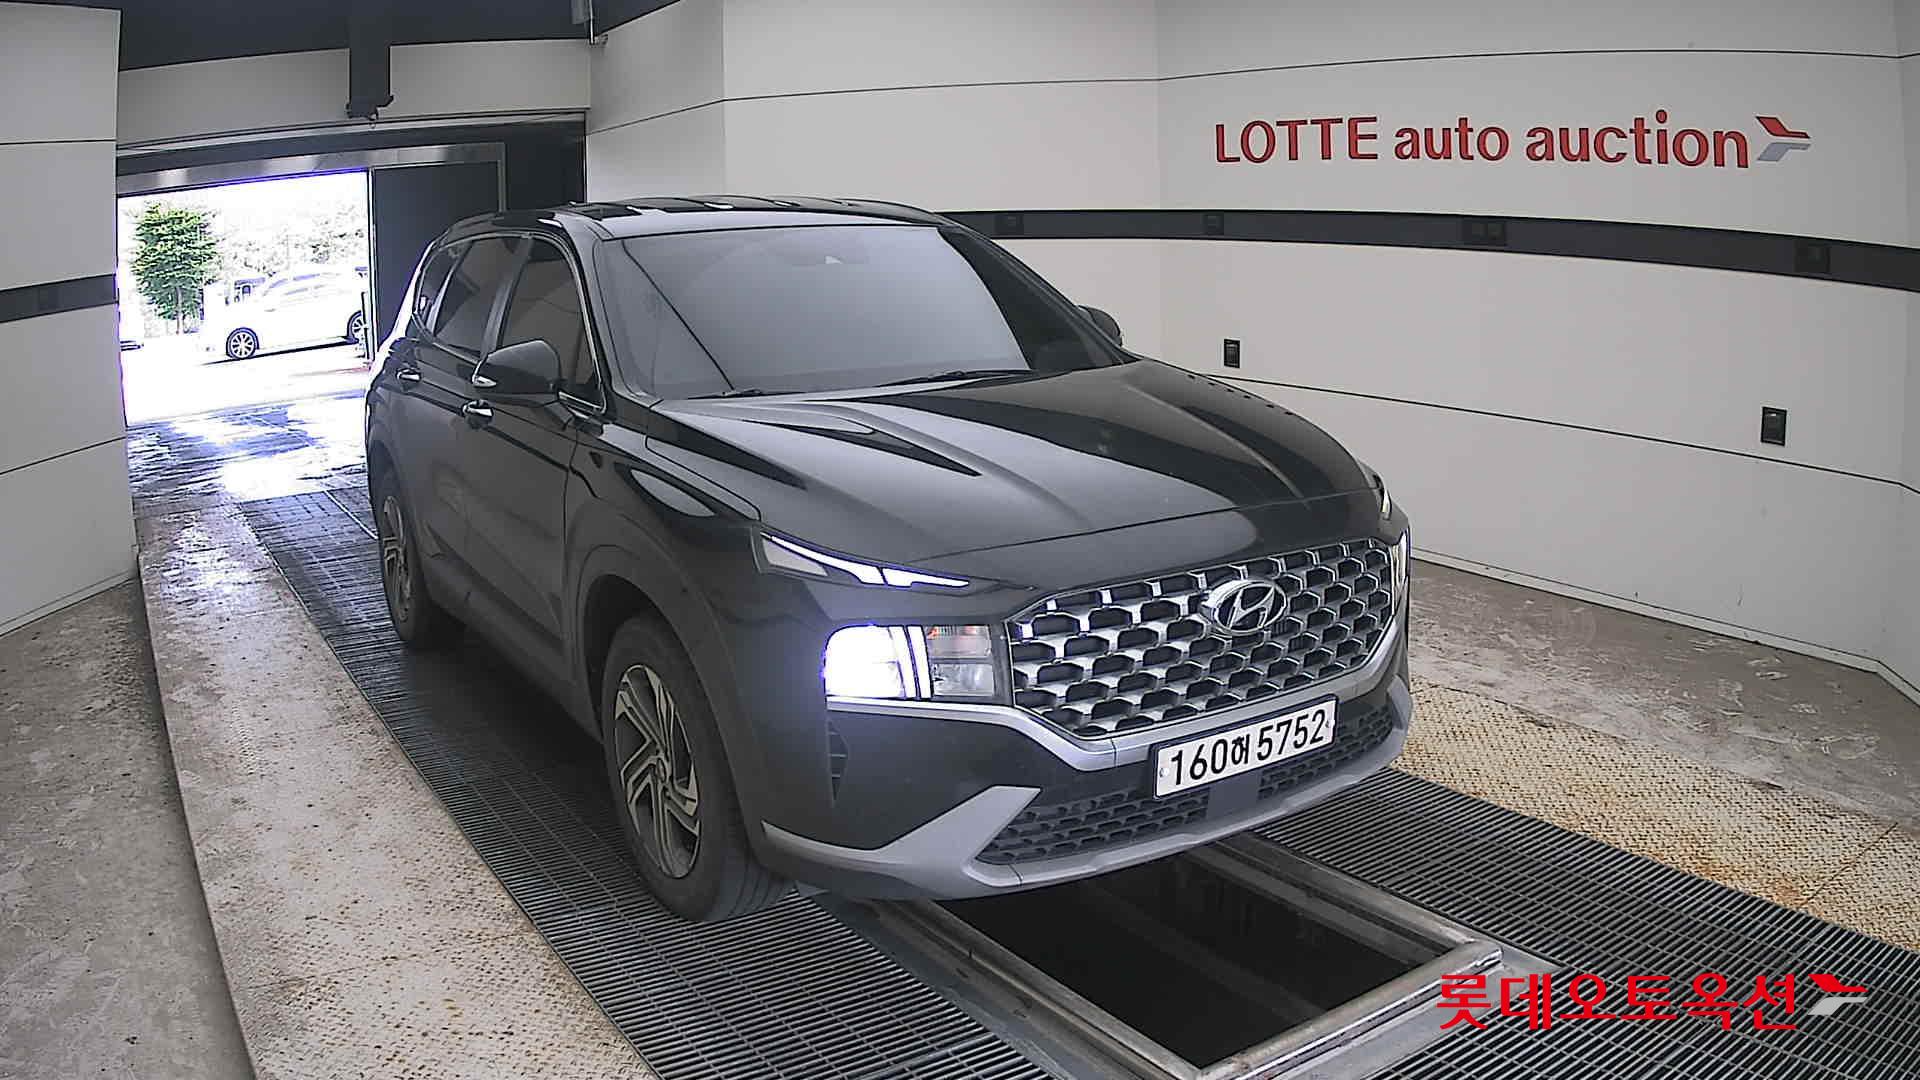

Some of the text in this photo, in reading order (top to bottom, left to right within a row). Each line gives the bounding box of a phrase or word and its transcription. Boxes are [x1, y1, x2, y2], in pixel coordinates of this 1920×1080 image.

[1214, 109, 1750, 168] LOTTE auto auction
